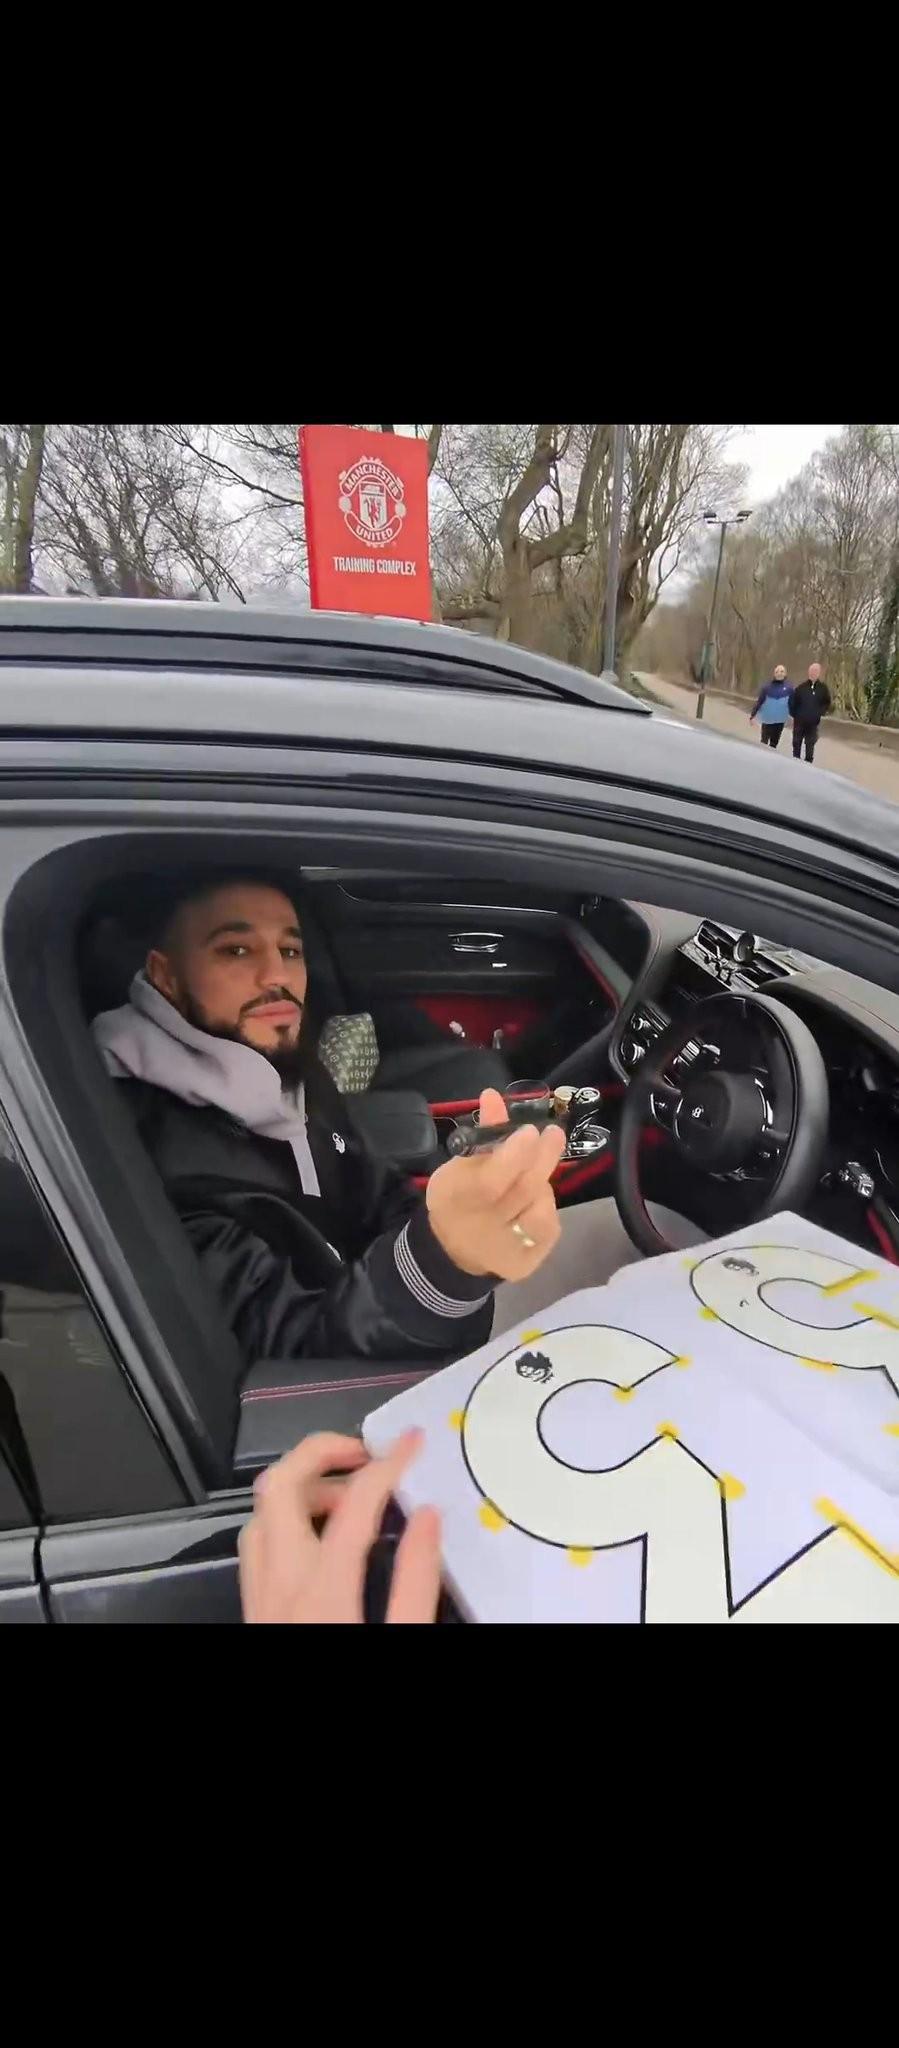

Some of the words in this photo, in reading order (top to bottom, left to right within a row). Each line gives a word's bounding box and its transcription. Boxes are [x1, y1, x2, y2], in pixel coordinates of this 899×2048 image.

[344, 464, 399, 496] MANCHESTER
[355, 524, 393, 541] UNITED
[333, 556, 375, 573] TRAINING
[376, 559, 416, 576] COMPLEX
